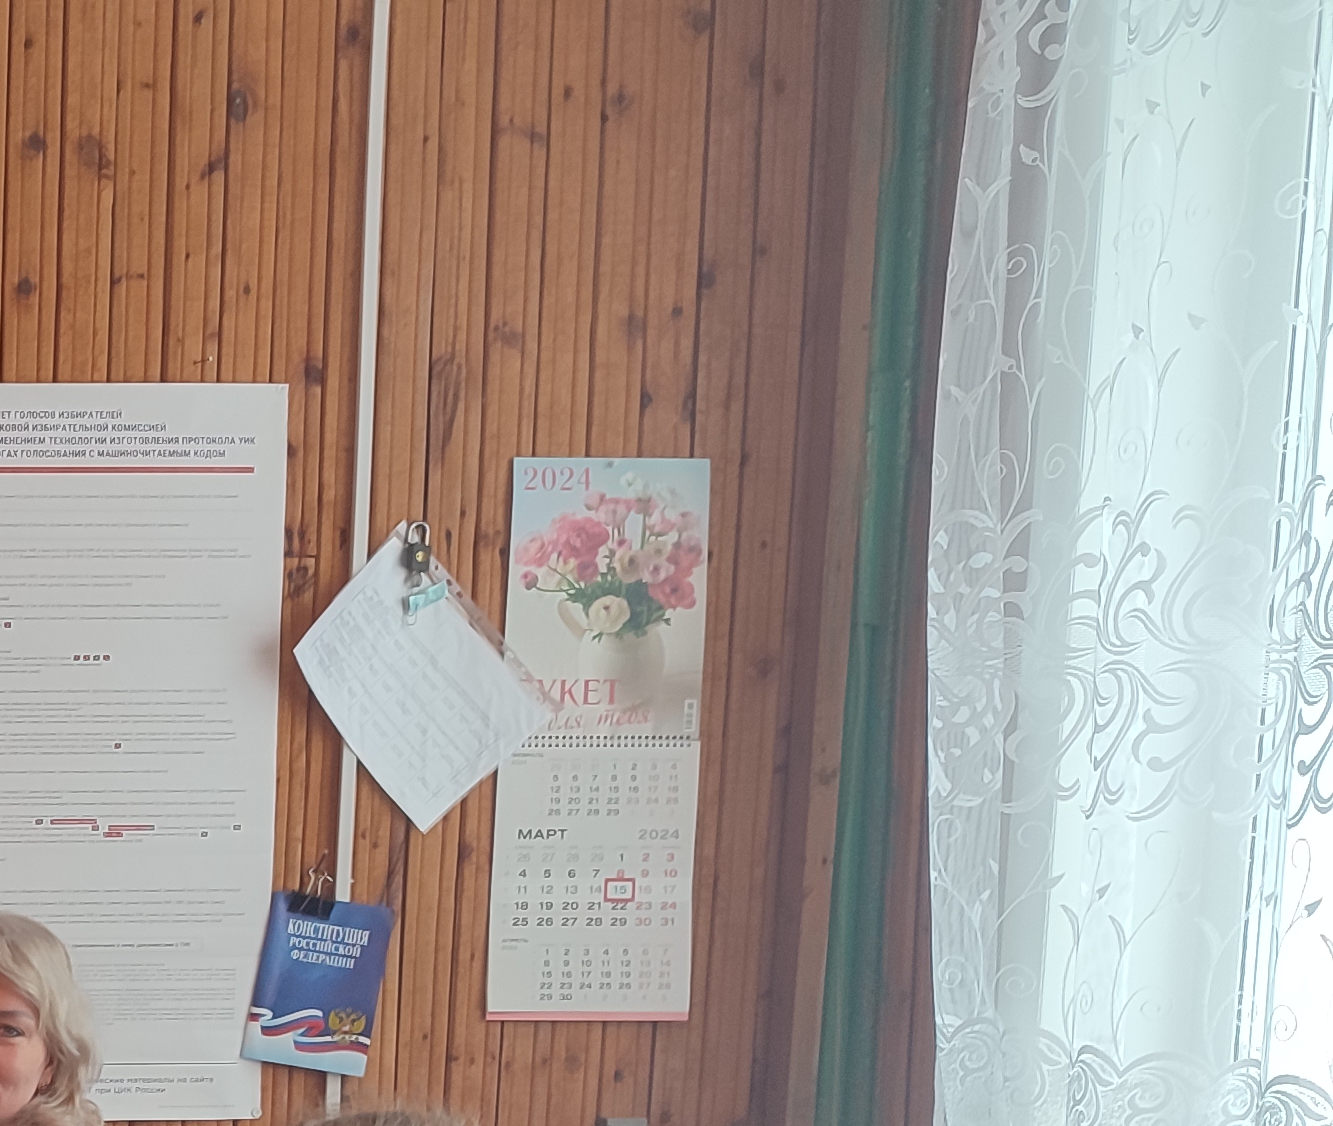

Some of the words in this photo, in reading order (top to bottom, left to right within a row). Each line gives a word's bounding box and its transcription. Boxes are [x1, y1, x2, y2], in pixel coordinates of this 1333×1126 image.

[14, 411, 56, 419] ГОЛОСОВ
[59, 409, 122, 419] ИЗБИРАТЕЛЕЙ
[32, 422, 109, 432] ИЗБИРАТЕЛЬНОЙ
[111, 422, 166, 432] КОМИССИЕЙ
[49, 436, 106, 445] ТЕХНОЛОГИИ
[109, 436, 179, 445] ИЗГОТОВЛЕНИЯ
[181, 436, 236, 445] ПРОТОКОЛА
[238, 437, 256, 445] УИК
[20, 449, 86, 458] ГОЛОСОВАНИЯ
[88, 449, 95, 458] С
[97, 449, 191, 458] МАШИНОЧИТАЕМЫМ
[193, 449, 226, 459] КОДОМ
[523, 466, 591, 491] 2024
[520, 678, 620, 707] УКЕТ
[518, 829, 568, 840] МАРТ
[638, 829, 680, 840] 2024
[664, 869, 677, 878] 10
[516, 885, 528, 894] 11
[540, 885, 553, 894] 12
[565, 885, 578, 894] 13
[589, 885, 602, 894] 14
[614, 885, 627, 894] 15
[514, 901, 528, 910] 18
[539, 901, 553, 910] 19
[561, 901, 579, 910] 20
[587, 901, 601, 910] 21
[611, 901, 627, 910] 22
[635, 901, 652, 910] 23
[660, 901, 676, 910] 24
[512, 917, 528, 927] 25
[536, 917, 553, 927] 26
[561, 917, 578, 927] 27
[585, 917, 602, 927] 28
[610, 917, 627, 927] 29
[635, 917, 652, 927] 30
[660, 917, 675, 927] 31
[287, 918, 371, 946] КОНСТИТУЦИЯ
[289, 936, 362, 957] РОССИЙСКОЙ
[291, 950, 355, 969] ФЕДЕРАЦИИ
[540, 982, 553, 990] 22
[559, 982, 572, 990] 23
[579, 982, 592, 990] 24
[598, 982, 611, 990] 25
[618, 982, 631, 990] 26
